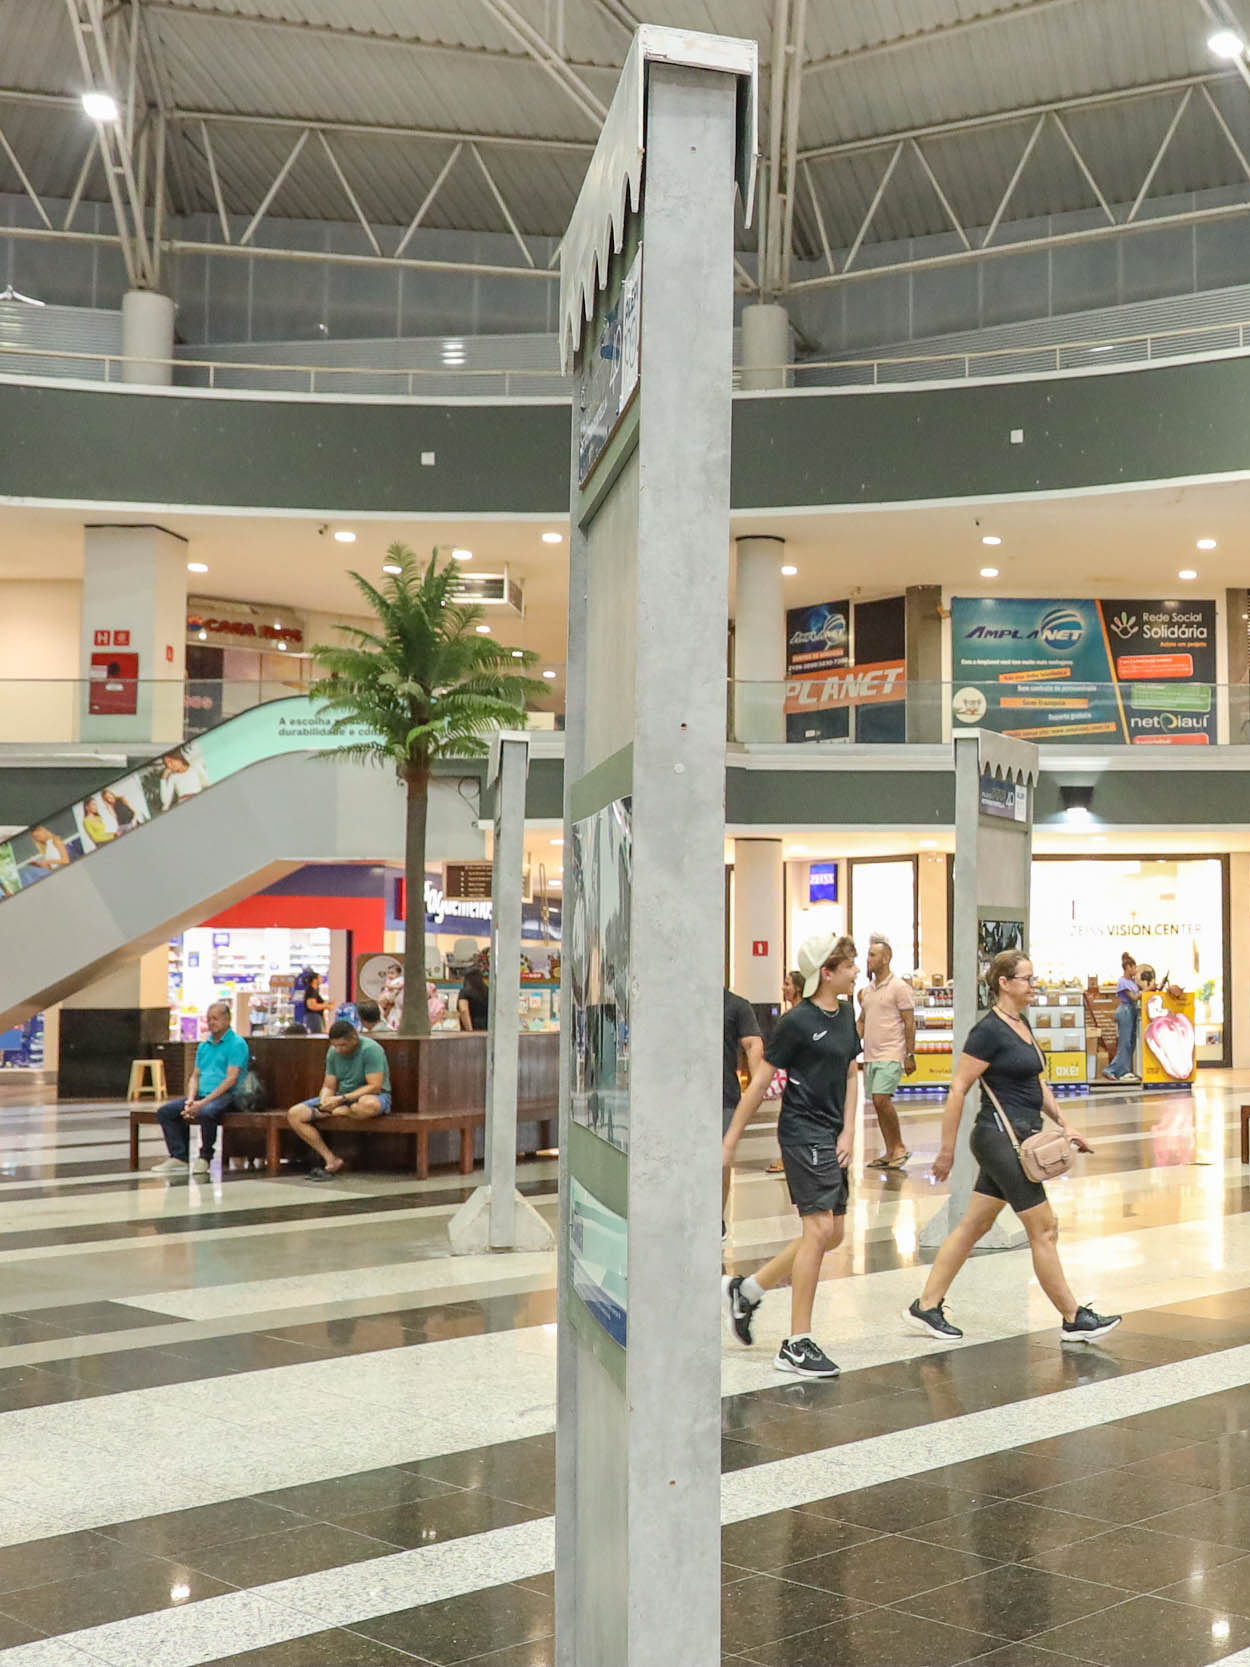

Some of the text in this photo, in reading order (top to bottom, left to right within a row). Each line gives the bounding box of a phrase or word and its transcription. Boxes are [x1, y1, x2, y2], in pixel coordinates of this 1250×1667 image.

[1143, 612, 1202, 622] Rede Social
[1143, 624, 1207, 638] Solidária
[1106, 924, 1151, 936] VISION
[1154, 924, 1201, 936] CENTER
